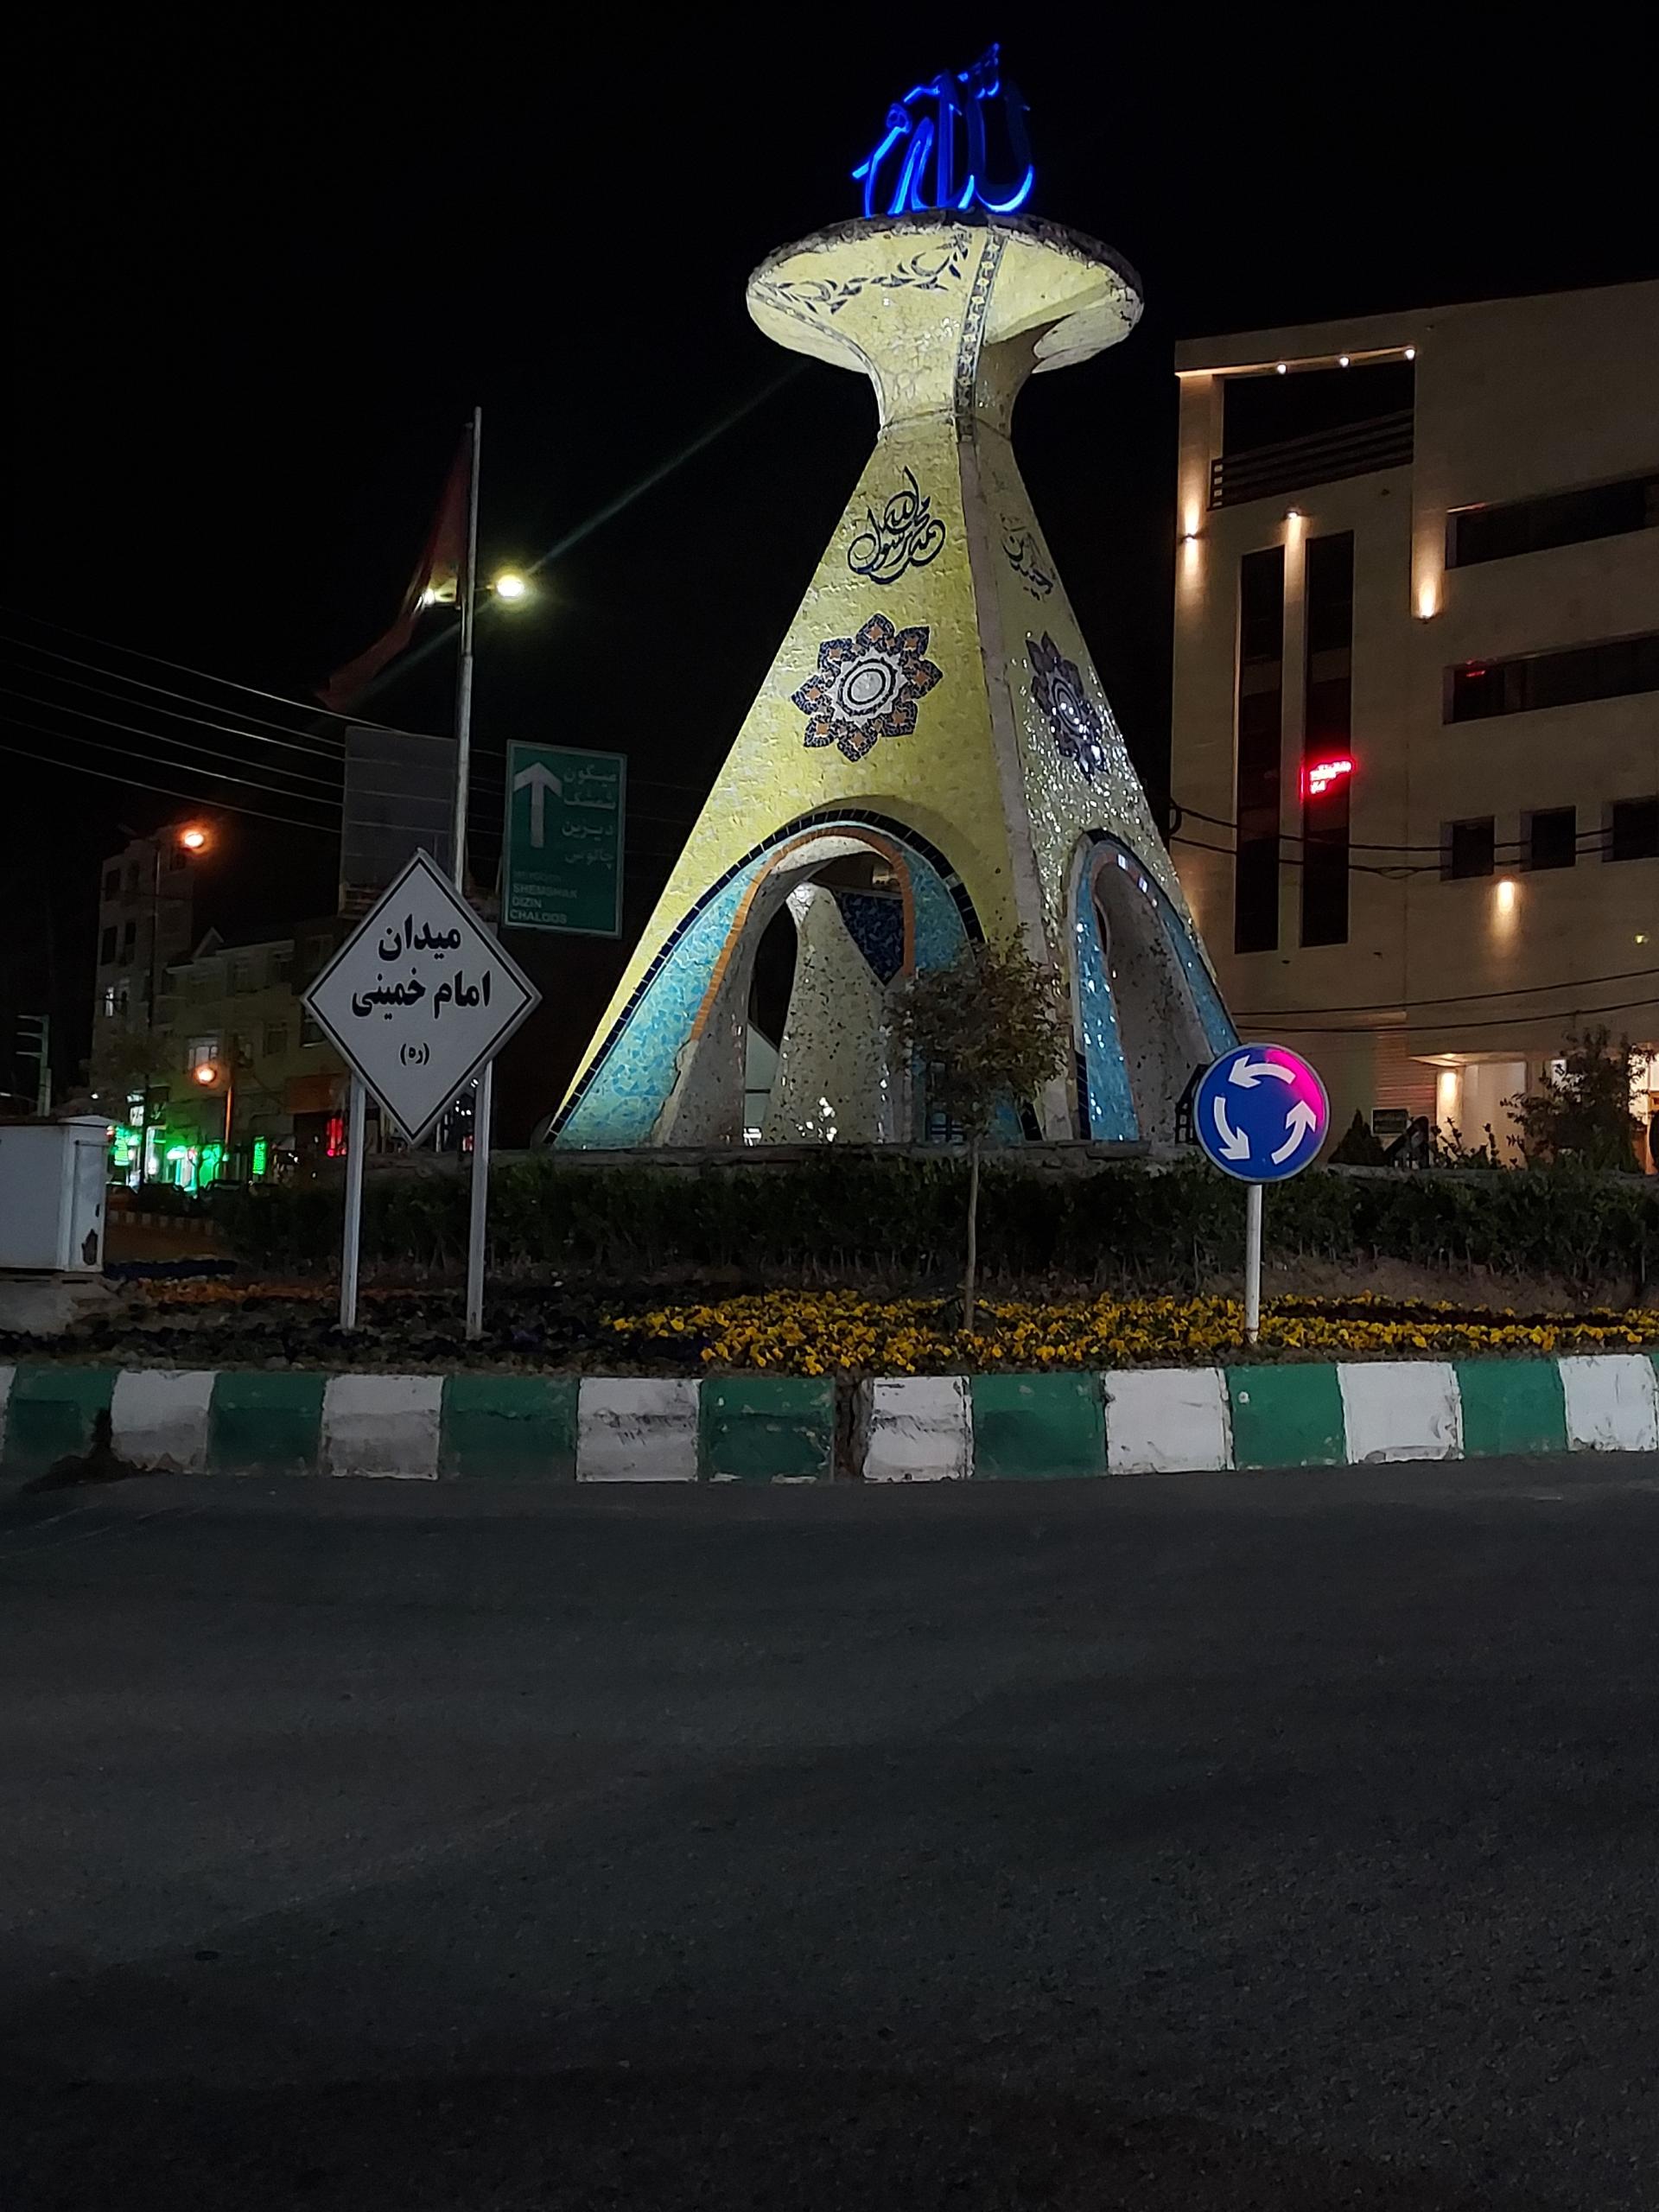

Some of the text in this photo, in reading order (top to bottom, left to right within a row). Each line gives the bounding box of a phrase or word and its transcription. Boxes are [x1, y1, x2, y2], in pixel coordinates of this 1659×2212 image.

[378, 913, 461, 962] میدان
[352, 967, 491, 1020] امام خمینی
